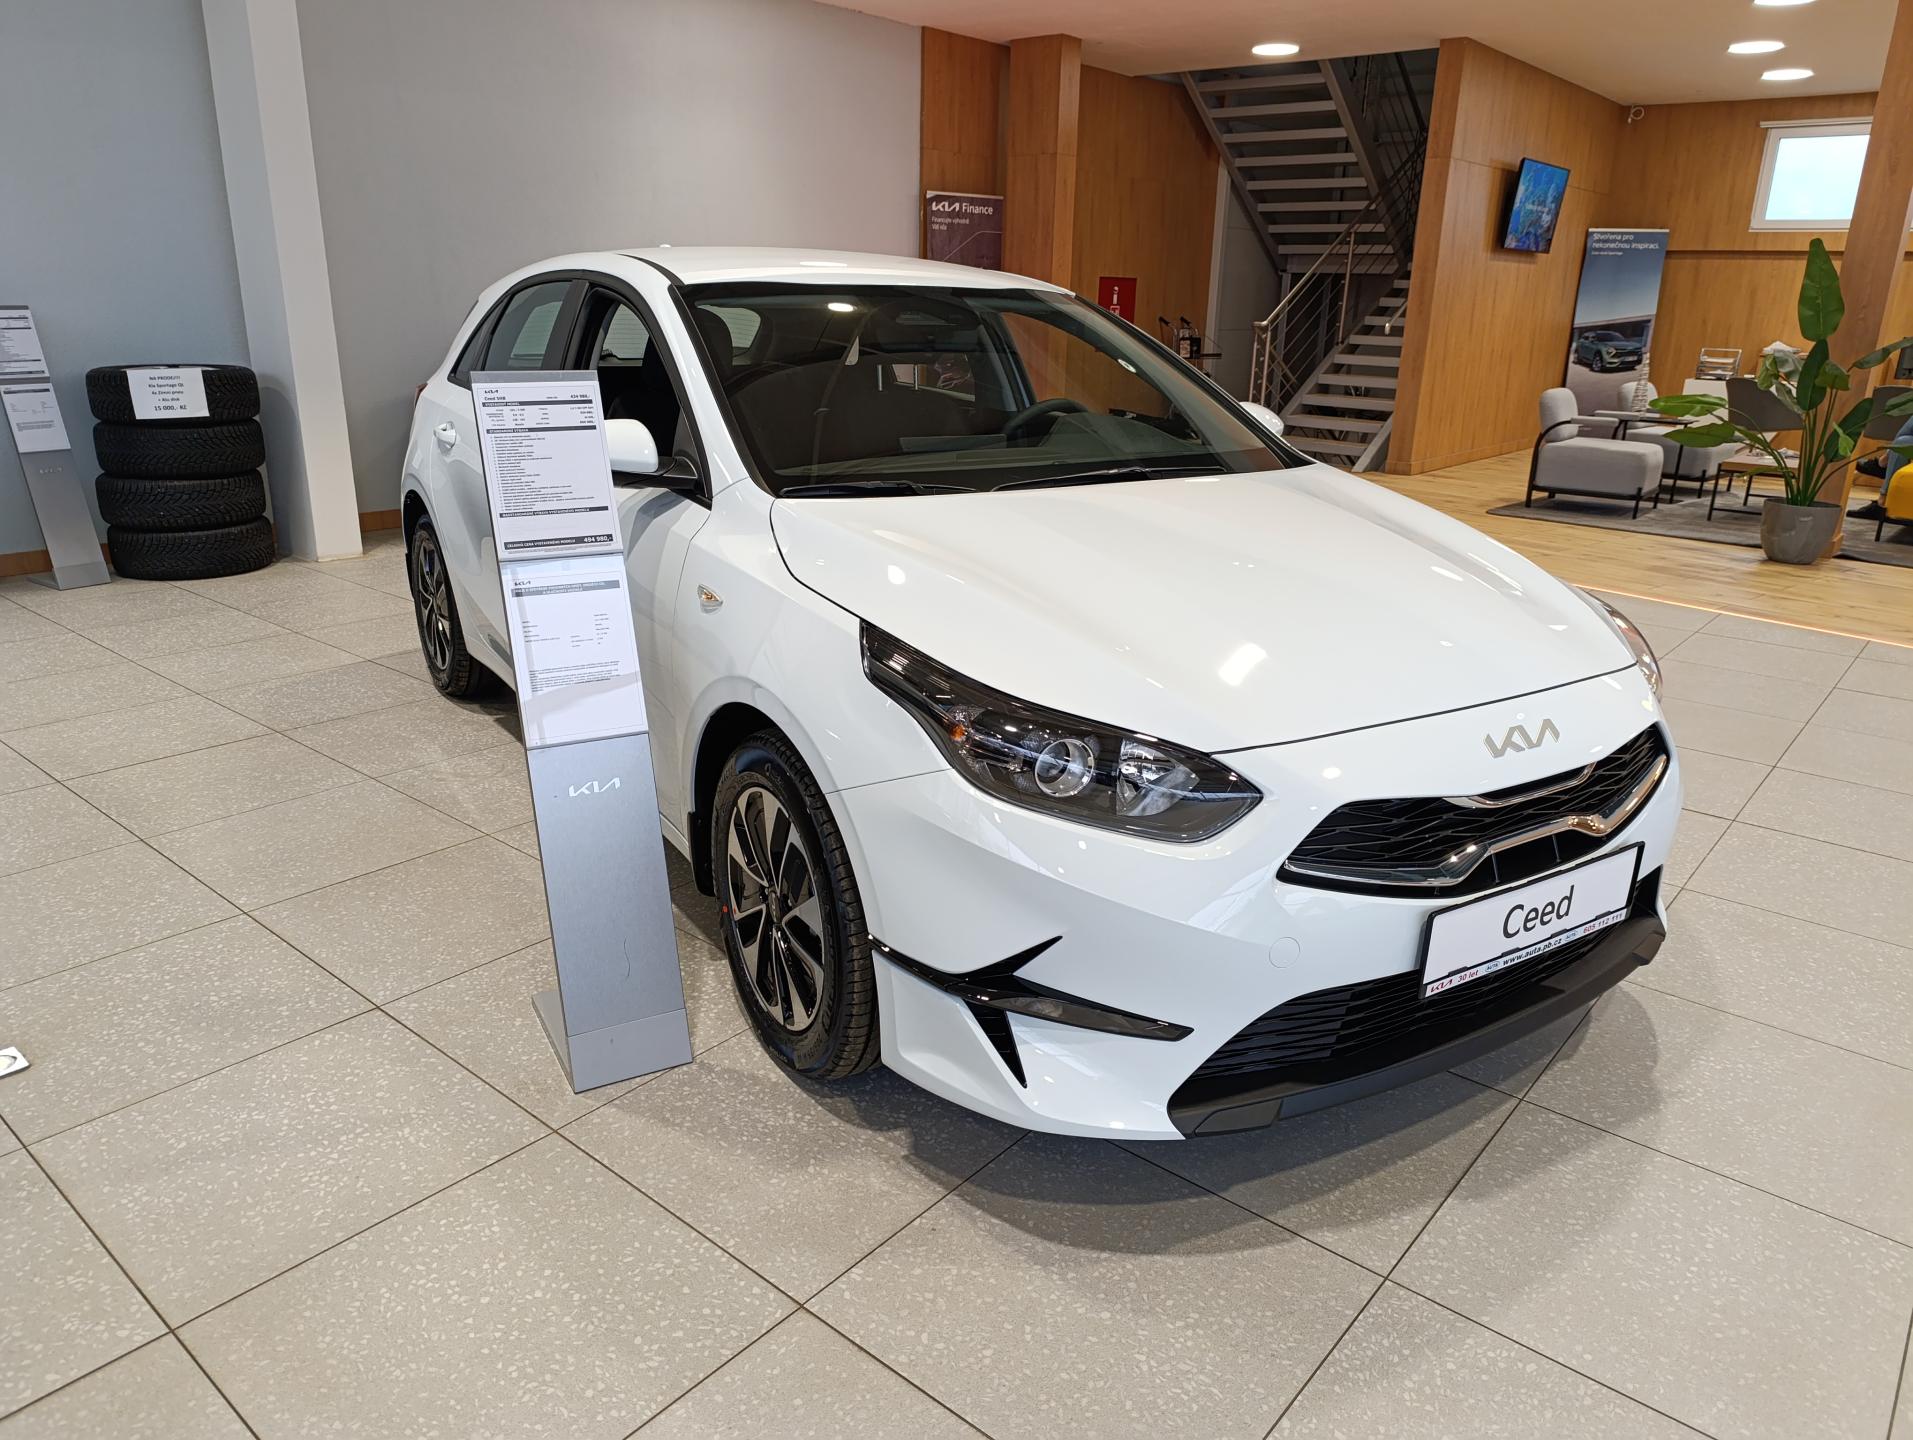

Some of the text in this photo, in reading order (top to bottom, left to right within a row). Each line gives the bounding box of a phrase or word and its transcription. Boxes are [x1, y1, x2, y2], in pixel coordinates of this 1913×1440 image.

[932, 201, 993, 215] KIA Finance
[1484, 718, 1560, 759] KIA
[569, 777, 620, 797] KIA
[1502, 884, 1575, 939] Ceed
[1430, 979, 1453, 993] KIA
[1458, 974, 1467, 983] 30
[1468, 969, 1479, 979] let
[1502, 938, 1562, 966] www.auta.pb.cz
[1583, 923, 1596, 934] 605
